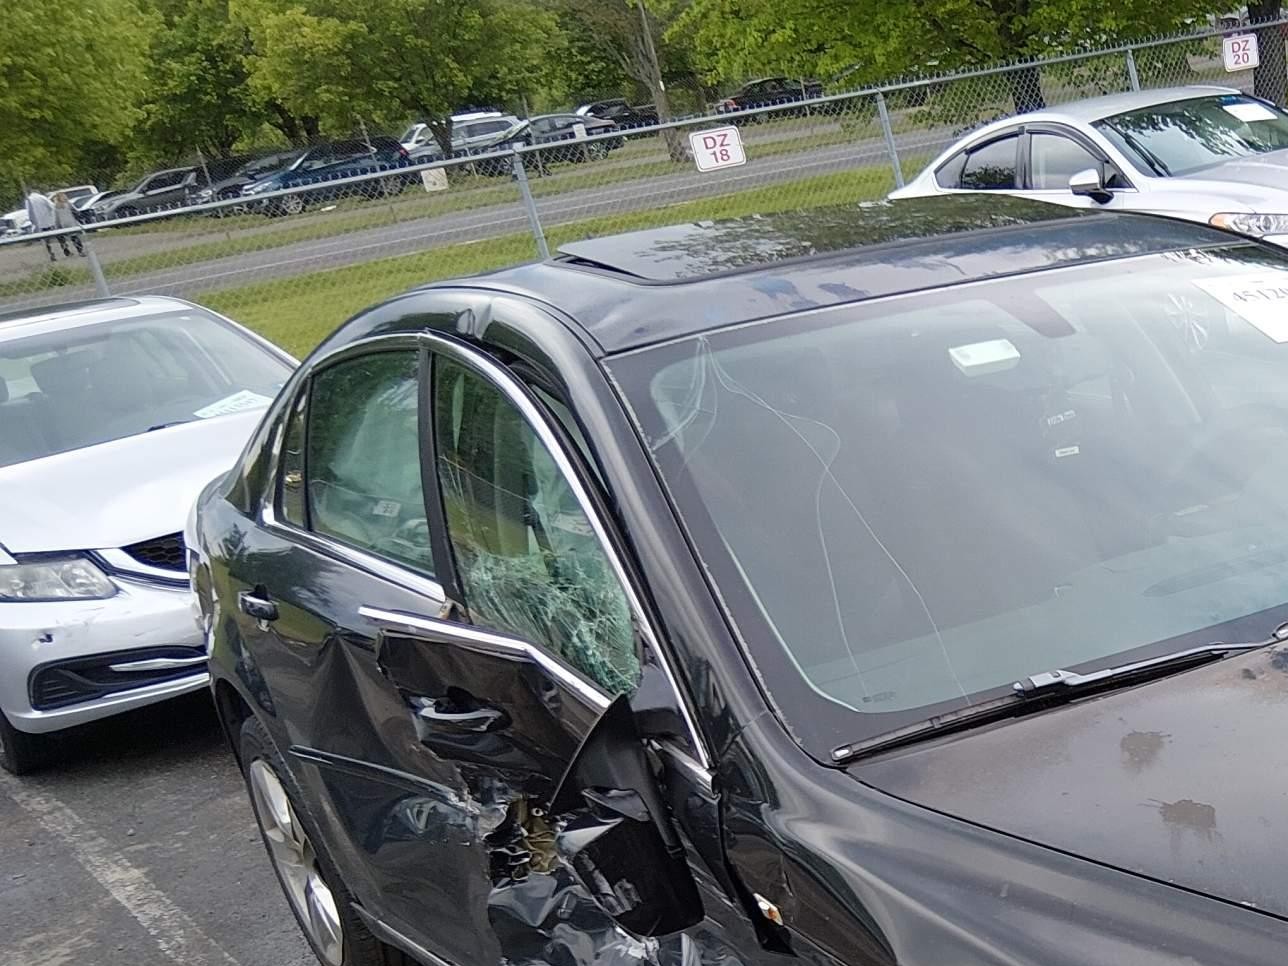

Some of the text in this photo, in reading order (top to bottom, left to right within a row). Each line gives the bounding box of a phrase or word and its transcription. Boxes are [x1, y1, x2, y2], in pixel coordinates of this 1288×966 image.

[1231, 40, 1250, 53] DZ
[1233, 53, 1250, 65] 20
[702, 133, 731, 150] DZ
[709, 149, 731, 164] 18
